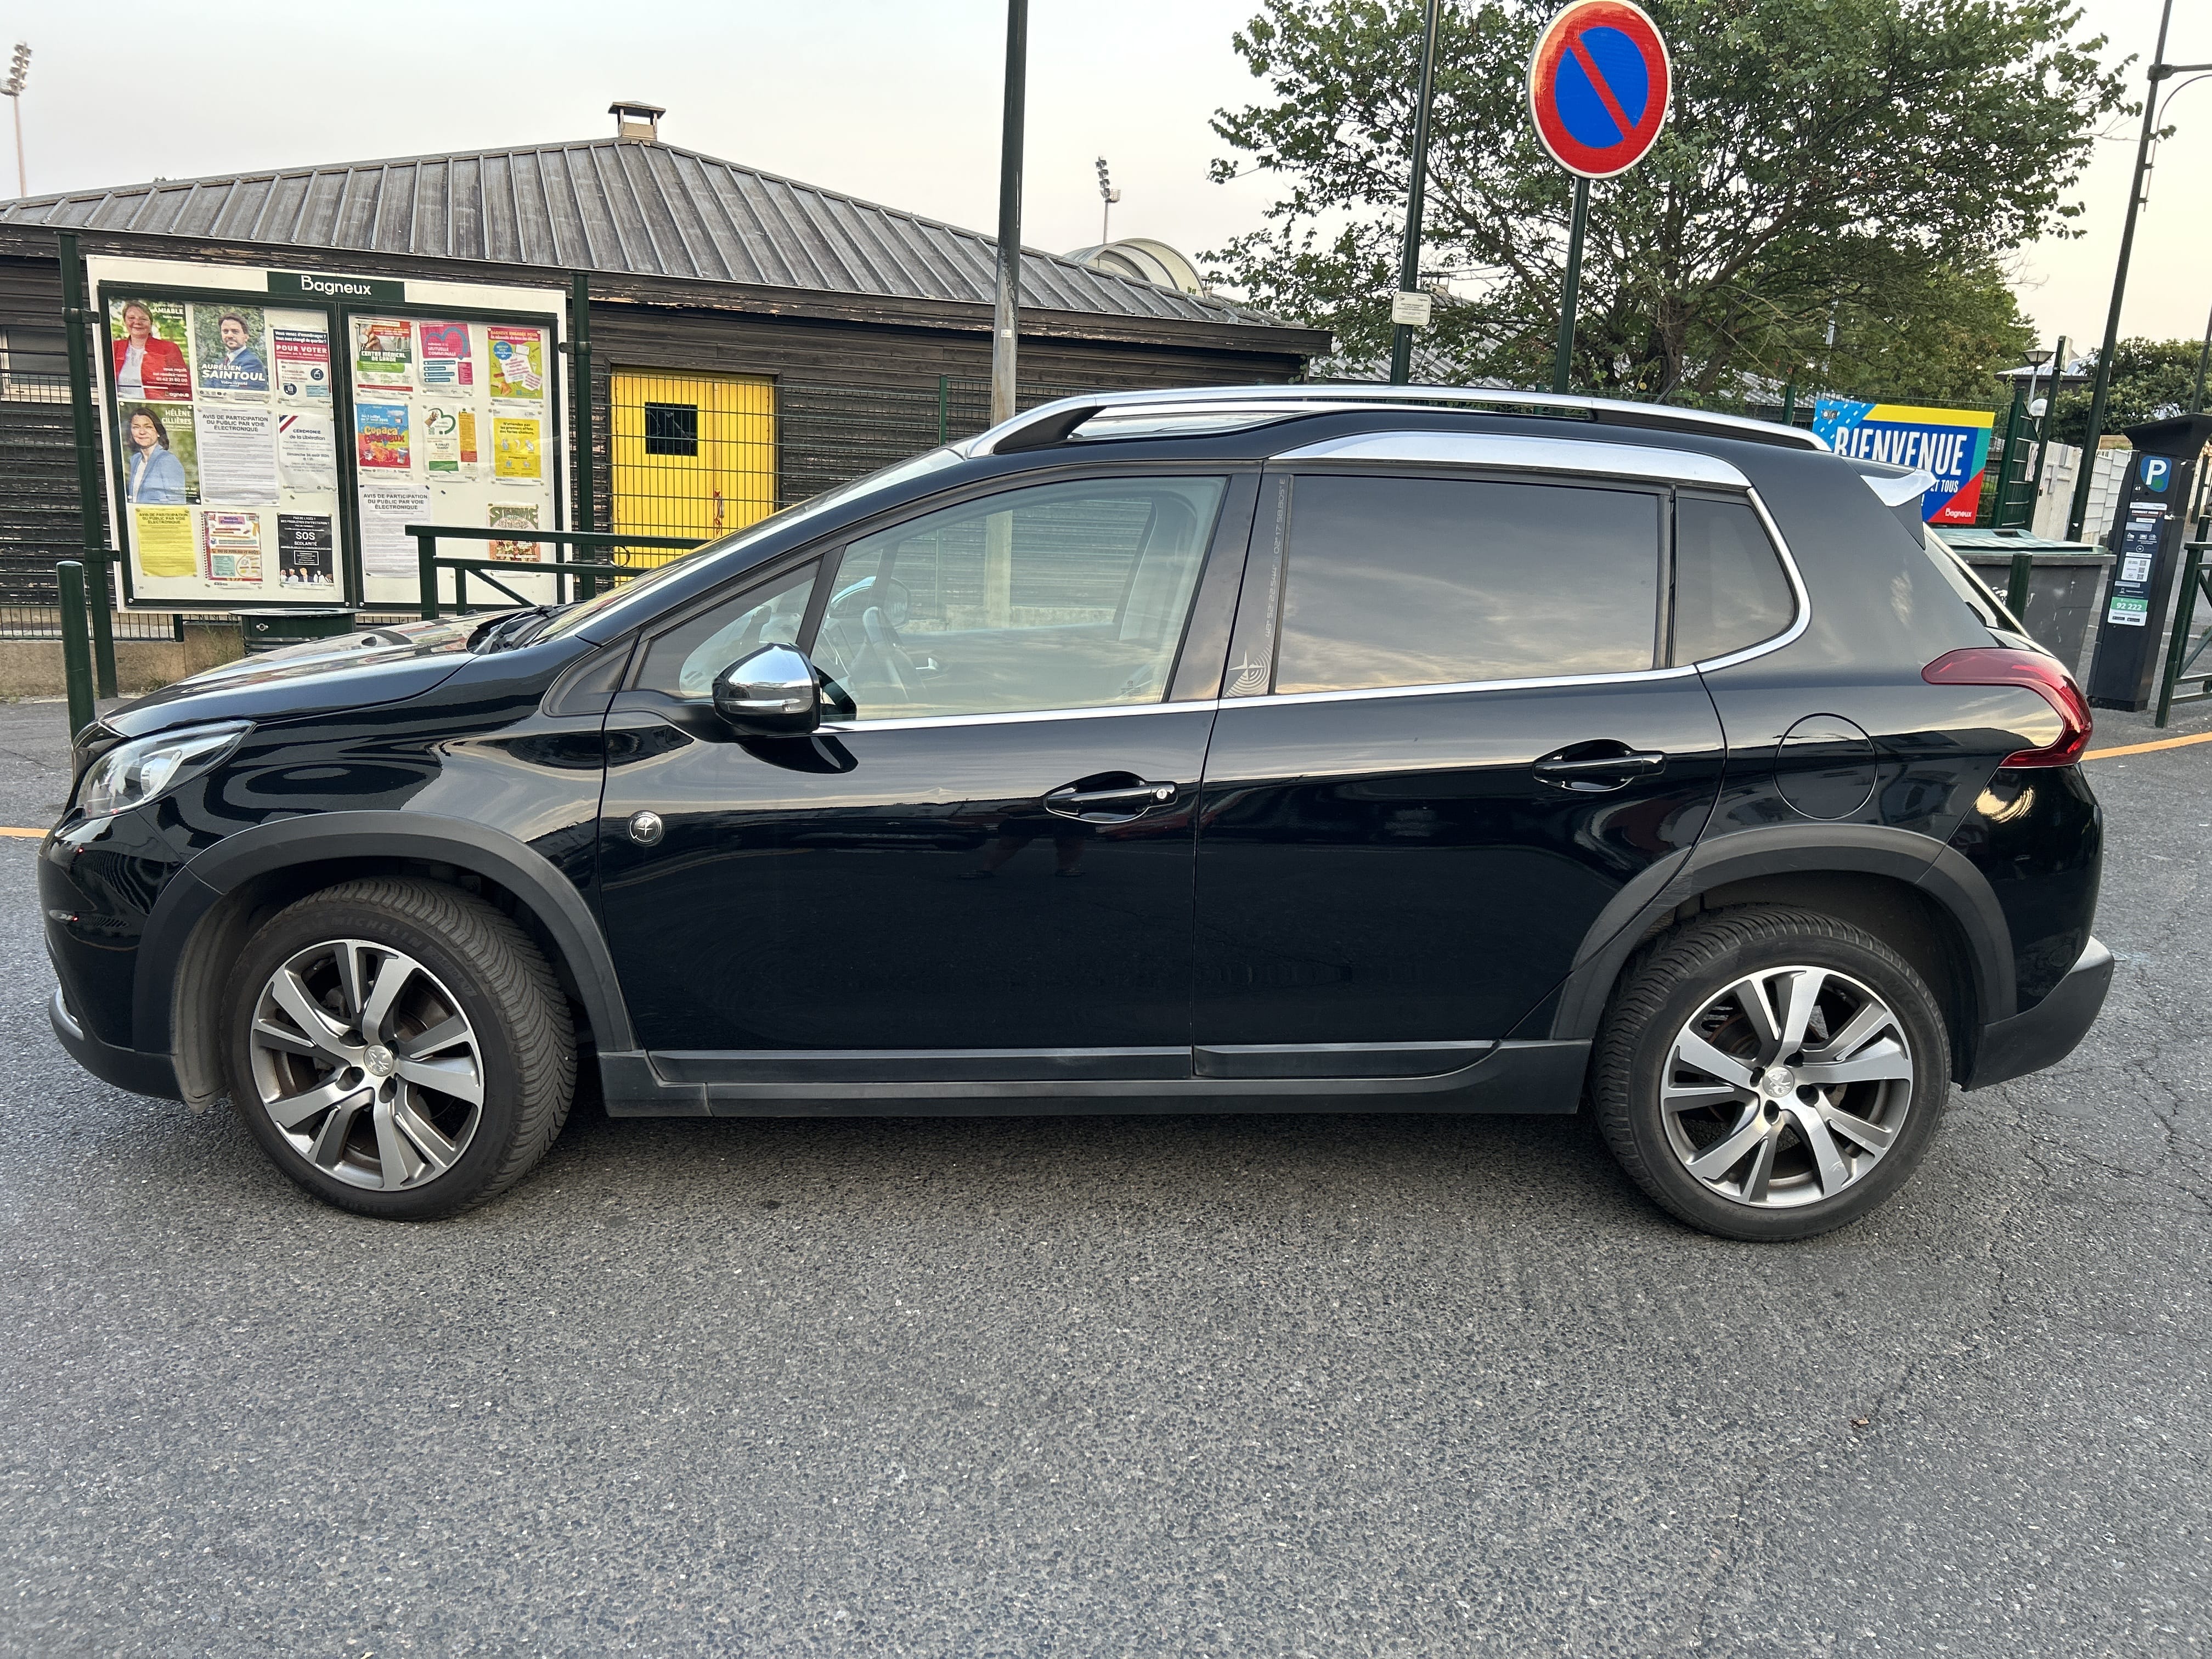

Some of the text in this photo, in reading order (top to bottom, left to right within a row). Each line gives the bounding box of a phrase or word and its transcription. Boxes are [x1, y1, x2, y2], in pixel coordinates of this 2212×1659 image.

[301, 275, 372, 295] Bagneux
[202, 369, 266, 381] SAINTOUL
[166, 408, 191, 417] HÉLÈNE
[1834, 426, 1967, 476] BIENVENUE
[2146, 460, 2167, 485] P
[1942, 479, 1959, 493] TOUS
[1945, 508, 1972, 518] Bagneux
[296, 531, 315, 540] SOS
[330, 916, 425, 948] MICHELIN
